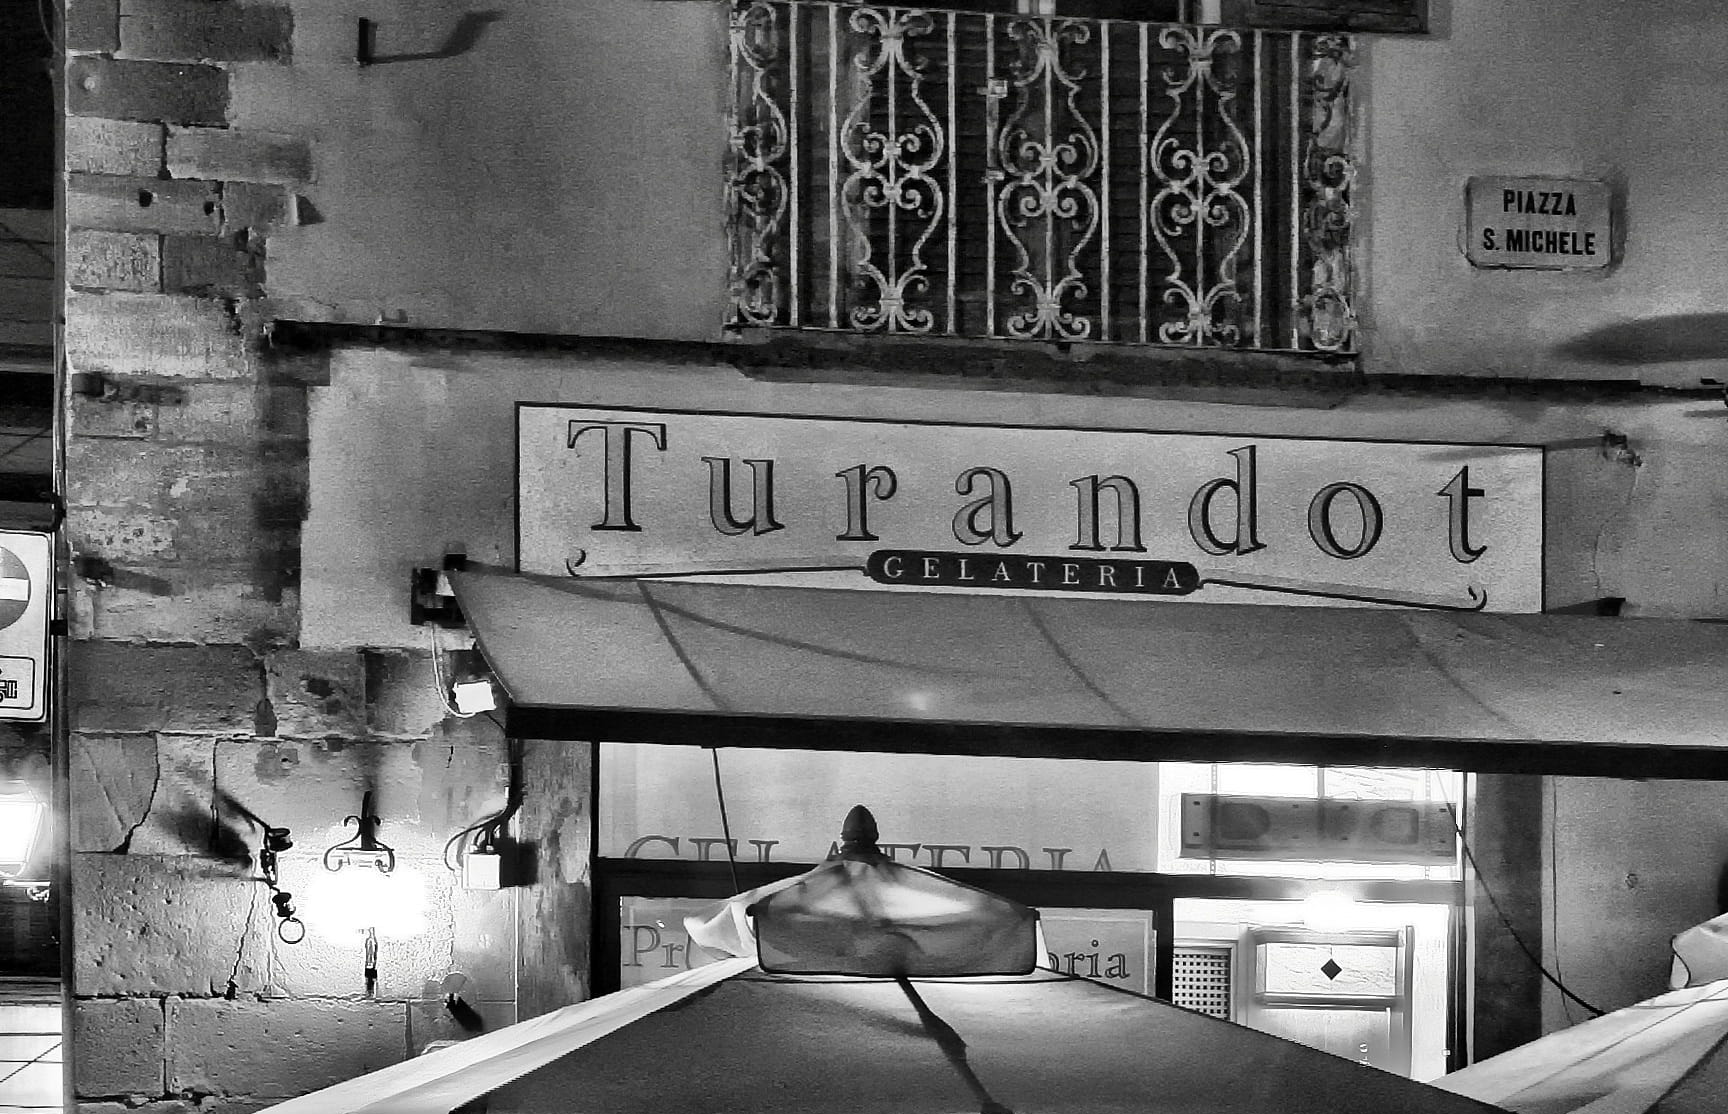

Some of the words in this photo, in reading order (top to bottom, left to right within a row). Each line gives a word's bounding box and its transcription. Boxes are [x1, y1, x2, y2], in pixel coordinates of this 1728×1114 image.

[1503, 189, 1577, 216] PIAZZA
[1483, 227, 1500, 251] S.
[1506, 229, 1596, 256] MICHELE
[567, 419, 1488, 565] Turandot
[882, 556, 1184, 591] GELATERIA
